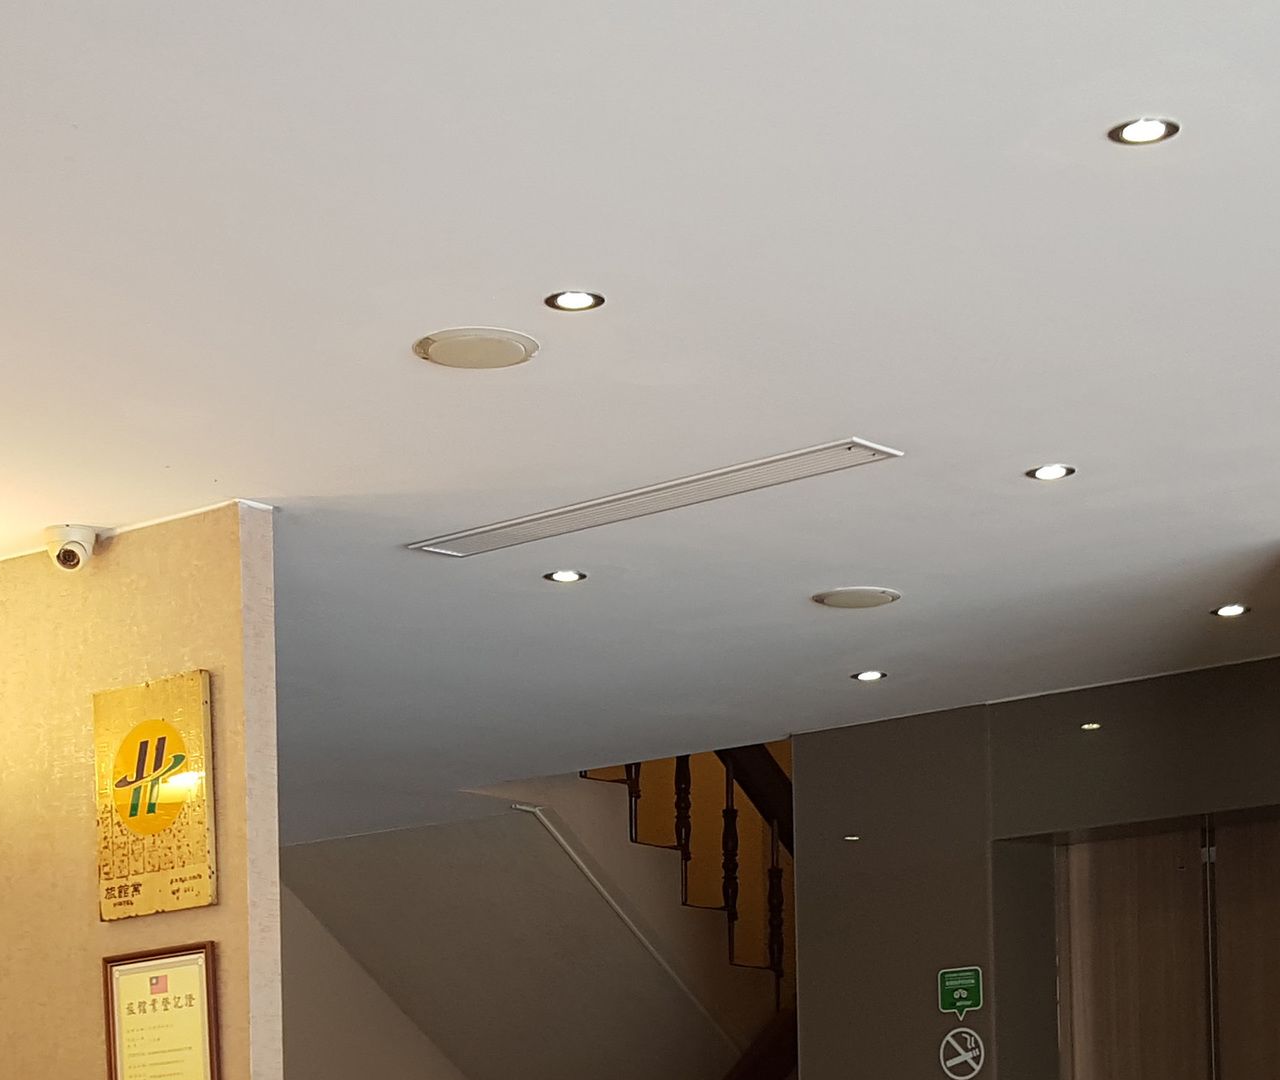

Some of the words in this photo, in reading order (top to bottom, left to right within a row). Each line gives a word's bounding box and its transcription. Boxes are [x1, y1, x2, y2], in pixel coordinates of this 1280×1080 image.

[104, 882, 142, 900] 旅館業
[126, 993, 196, 1016] 旅館業登記證
